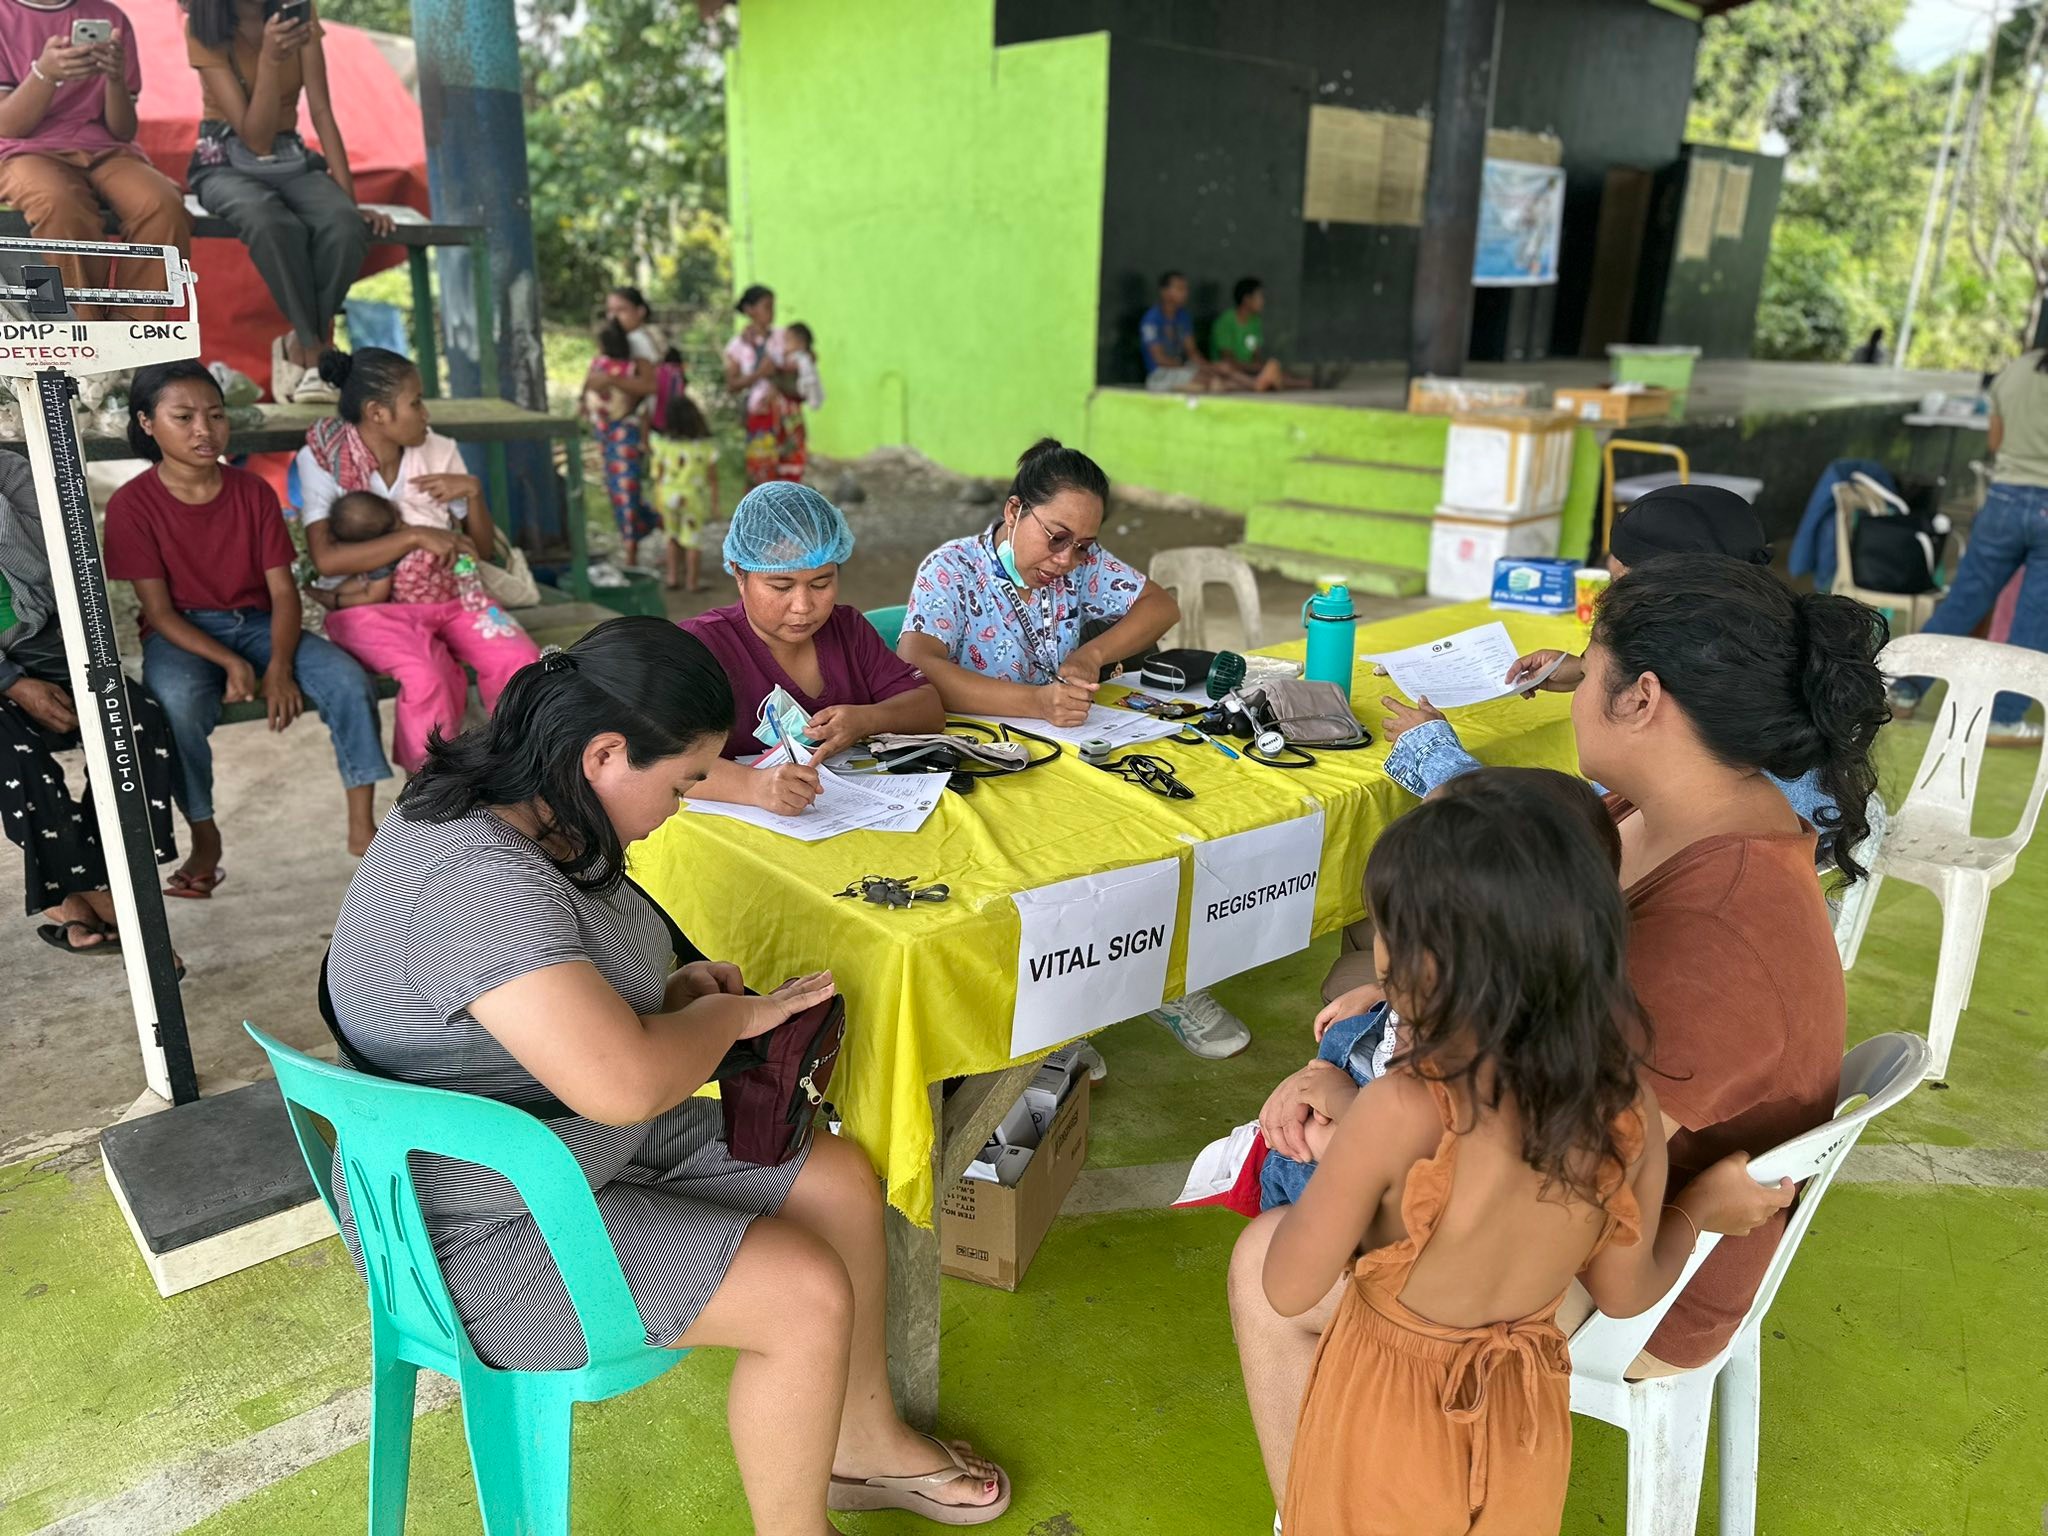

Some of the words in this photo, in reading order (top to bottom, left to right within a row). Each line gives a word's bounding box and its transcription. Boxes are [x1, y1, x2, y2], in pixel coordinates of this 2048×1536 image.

[0, 323, 88, 341] DMP-III
[0, 346, 95, 358] DETECTO
[105, 698, 135, 792] DETECTO
[1029, 943, 1100, 982] VITAL
[1108, 924, 1165, 961] SIGN
